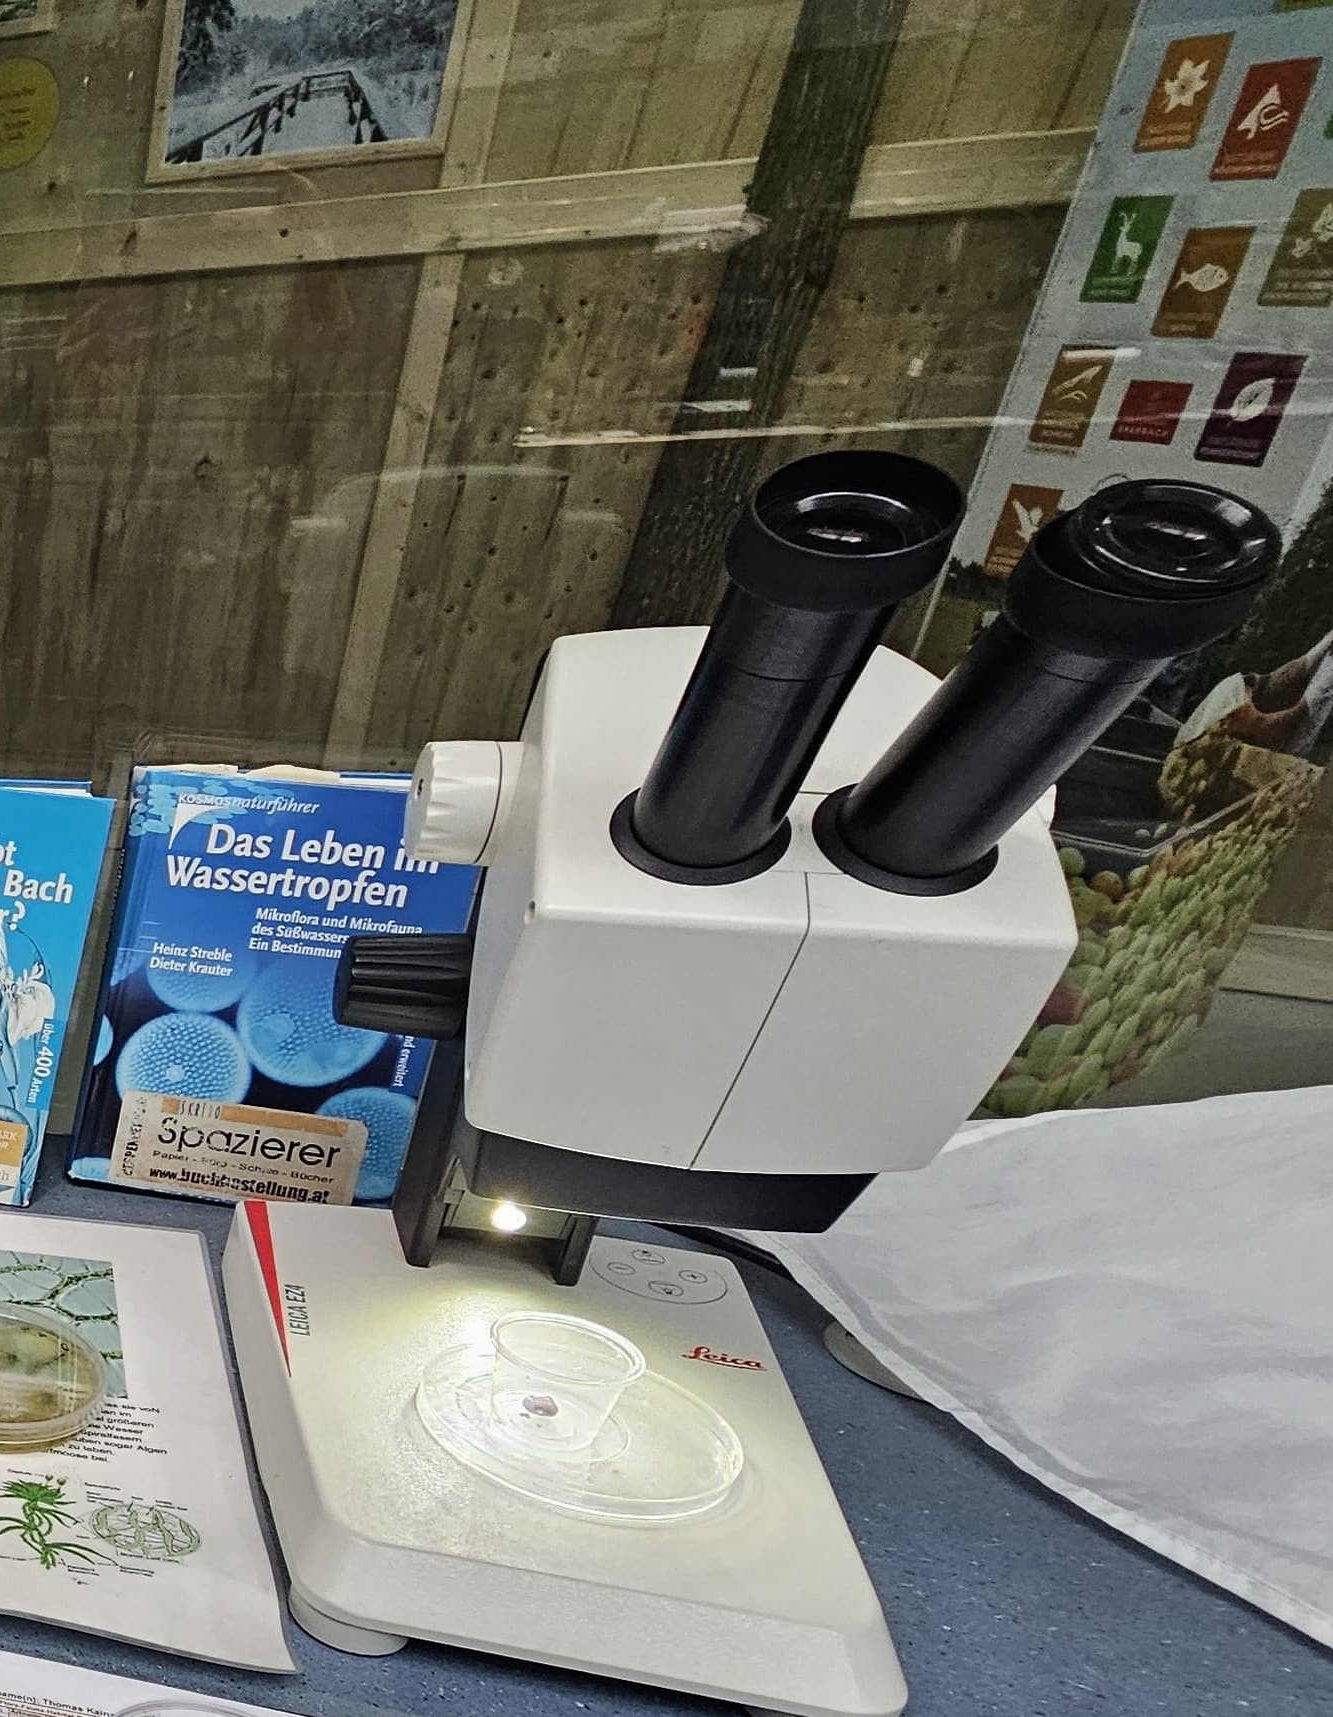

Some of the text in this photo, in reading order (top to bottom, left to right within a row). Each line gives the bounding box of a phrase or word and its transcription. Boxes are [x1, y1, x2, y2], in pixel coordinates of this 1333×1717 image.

[206, 824, 272, 859] Das
[282, 829, 385, 870] Leben
[3, 868, 74, 904] Bach
[166, 855, 408, 911] Wassertropfen
[252, 922, 350, 945] des Süßwassers
[255, 908, 423, 935] Mikroflora und Mikrofauna
[152, 943, 233, 963] Heinz Streble
[249, 938, 343, 959] Ein Bestimmun
[149, 957, 233, 978] Dieter Krauter
[28, 1022, 55, 1104] über 400 Arten
[158, 1116, 341, 1169] Spazierer
[152, 1150, 190, 1163] Papier
[290, 1170, 334, 1185] Bücher
[284, 1284, 311, 1337] LEICA EZ4
[681, 1346, 767, 1371] Leica
[103, 1423, 144, 1435] Wasser
[106, 1416, 155, 1430] größeren
[104, 1440, 168, 1456] sogar Algen
[42, 1698, 84, 1712] Thomas
